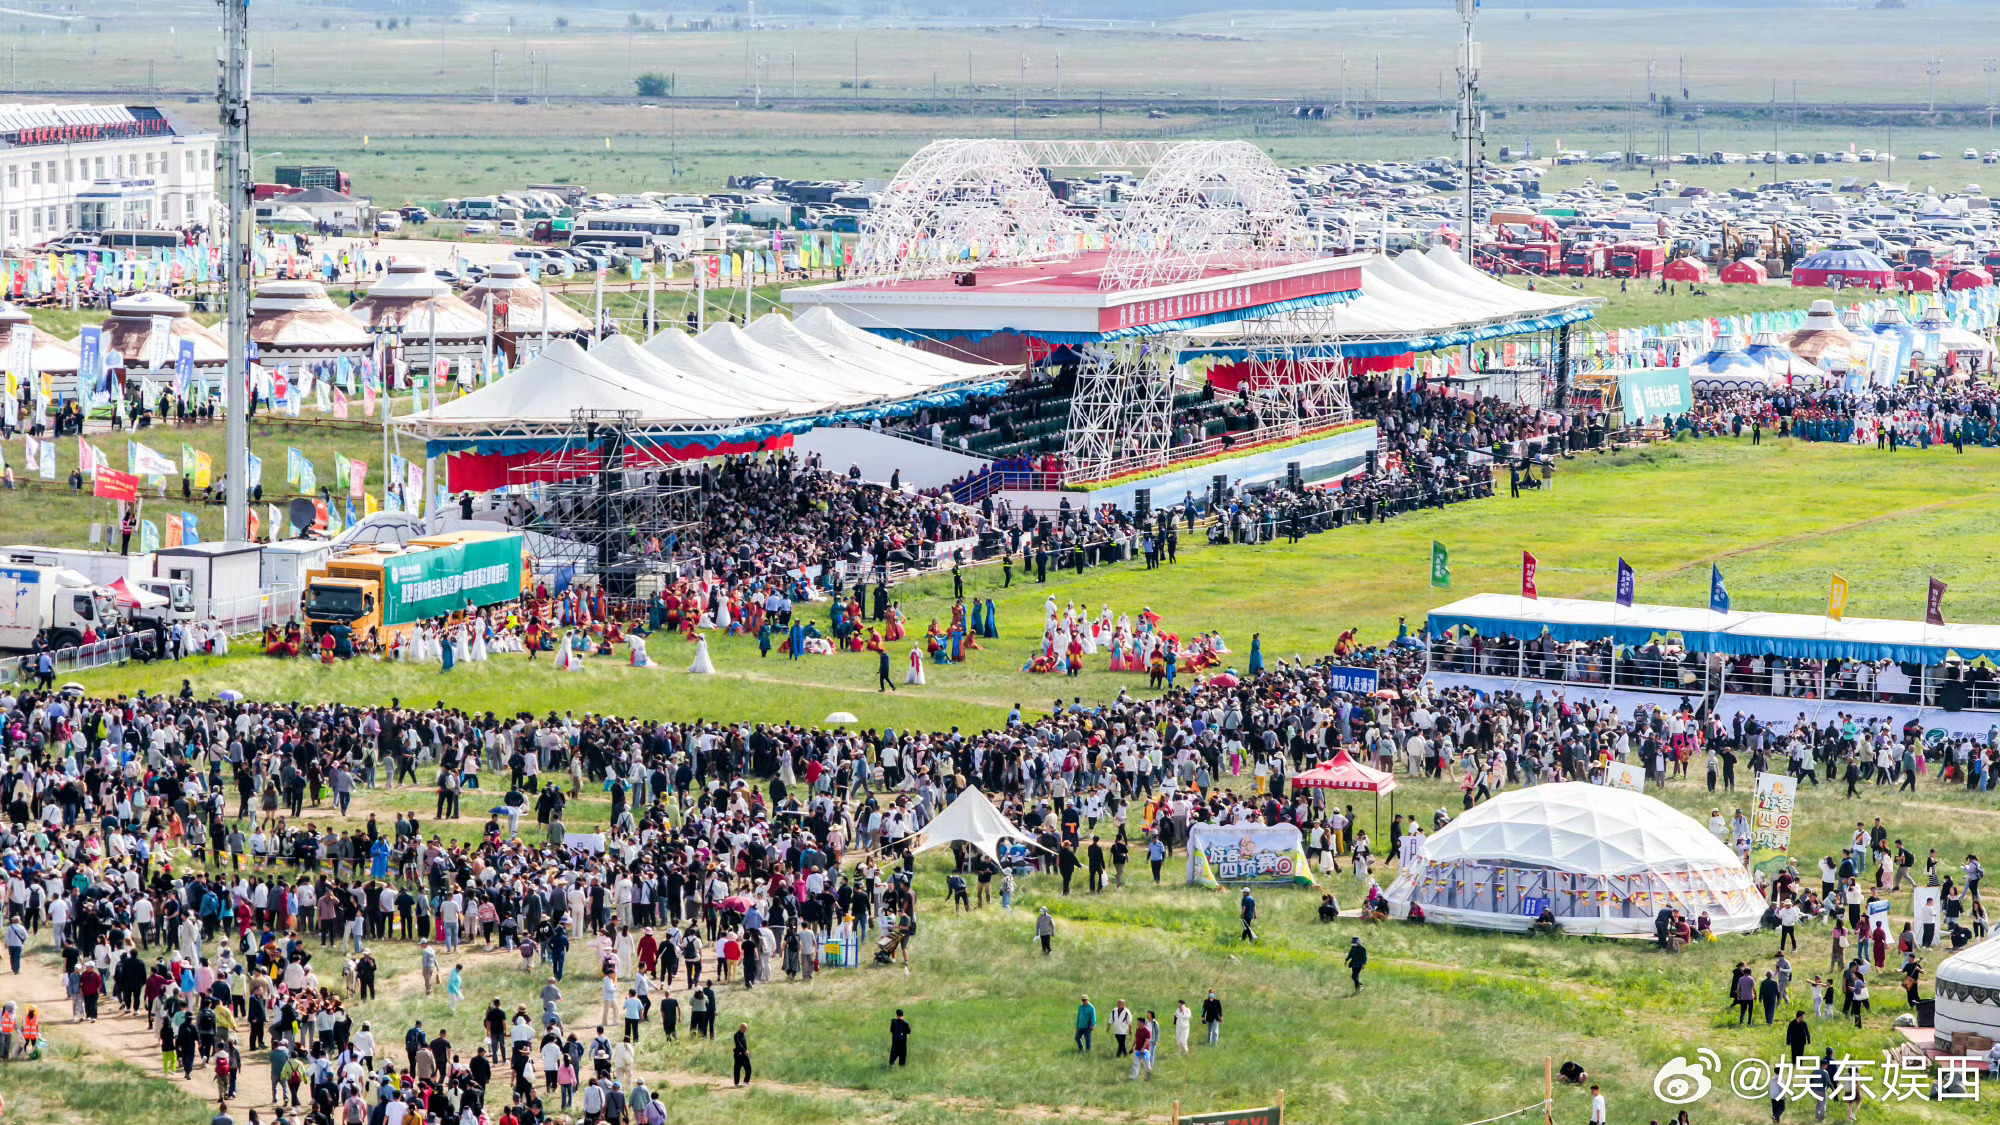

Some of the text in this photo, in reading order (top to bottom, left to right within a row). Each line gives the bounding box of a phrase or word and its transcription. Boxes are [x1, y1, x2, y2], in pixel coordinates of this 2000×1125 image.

[1759, 794, 1793, 813] 游客
[1758, 811, 1773, 829] 四
[1755, 829, 1789, 850] 项赛
[1205, 844, 1240, 863] 游客
[1219, 853, 1280, 879] 四项赛
